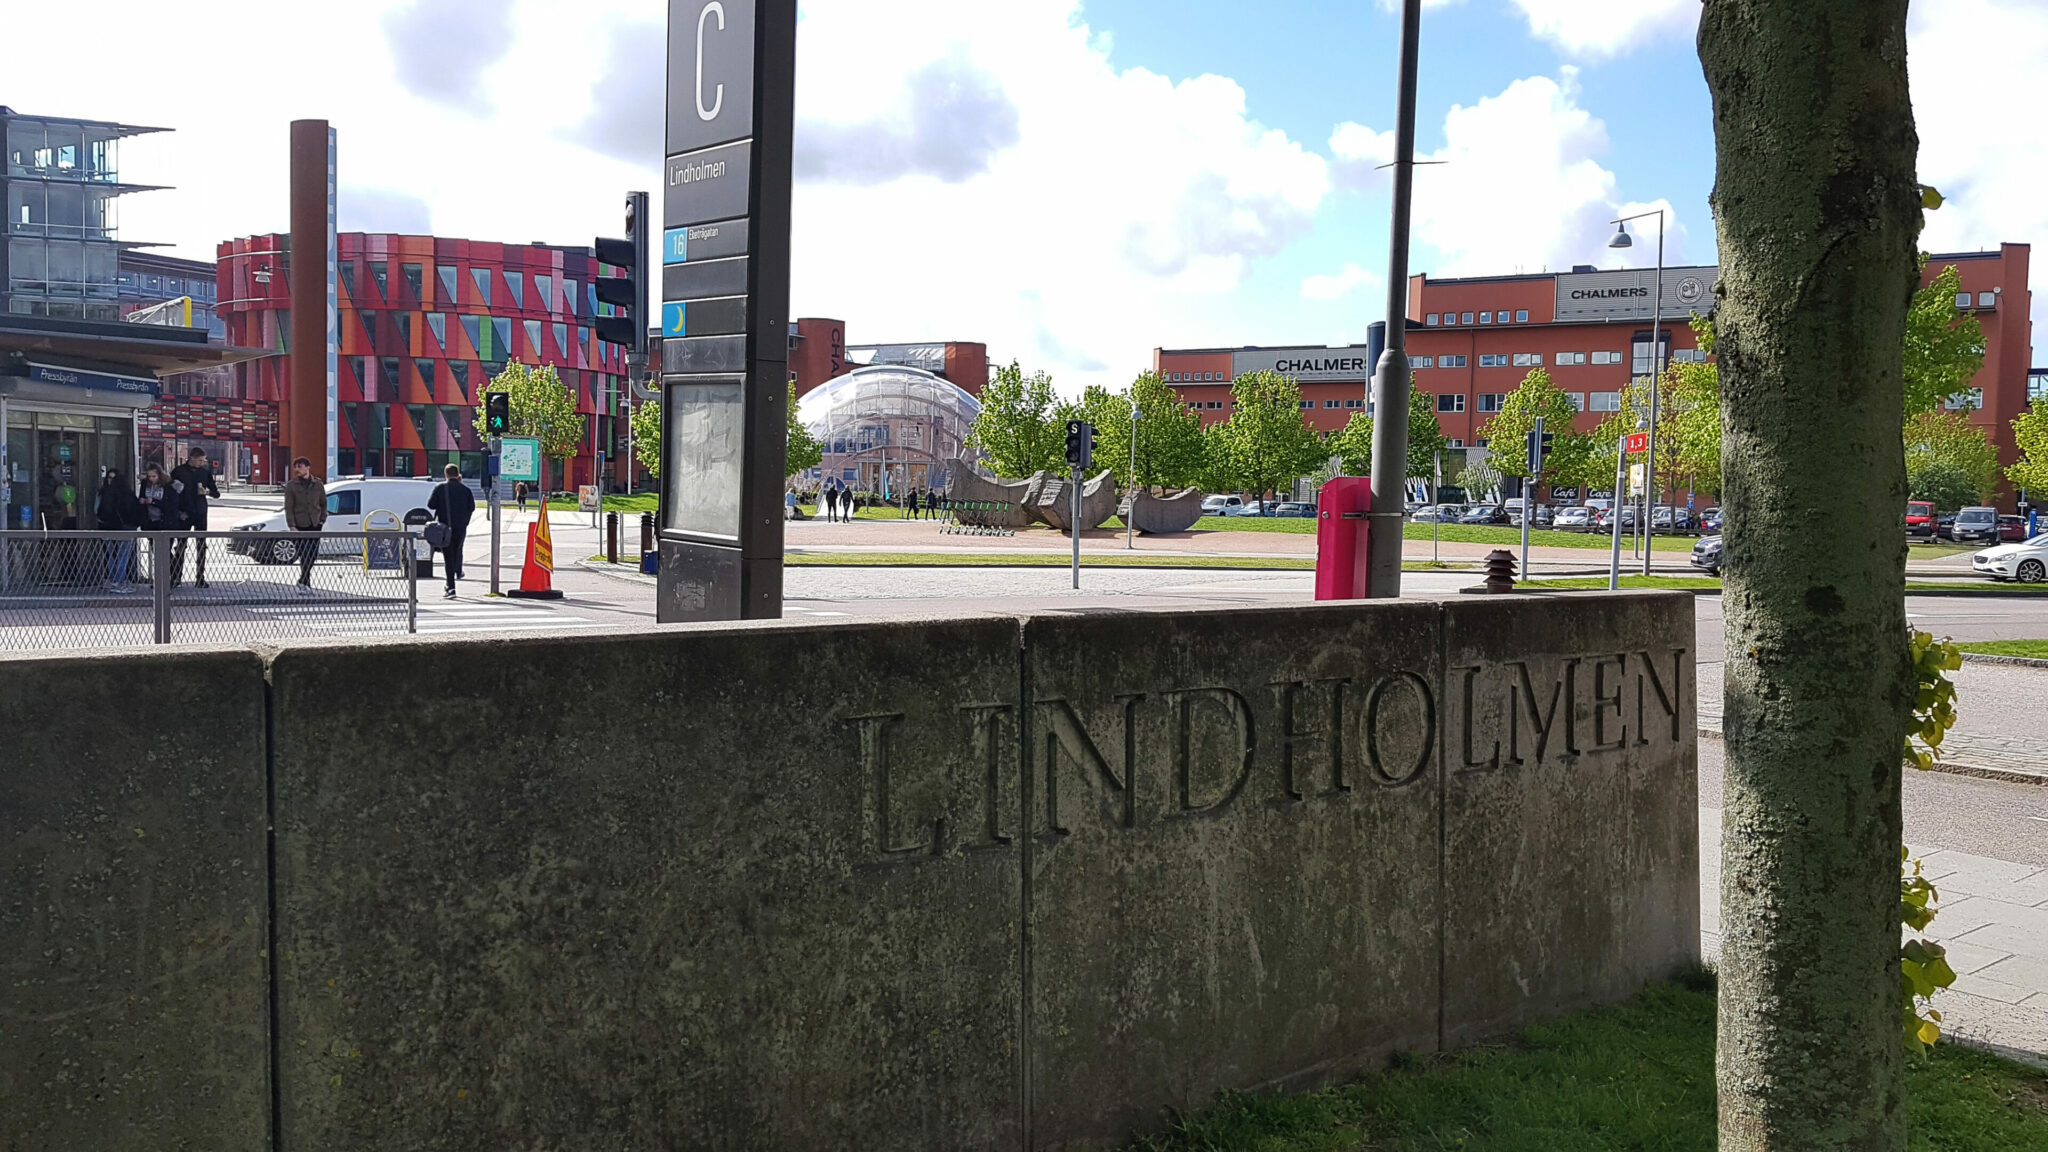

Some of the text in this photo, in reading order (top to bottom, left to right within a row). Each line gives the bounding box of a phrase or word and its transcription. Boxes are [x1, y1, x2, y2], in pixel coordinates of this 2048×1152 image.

[696, 1, 724, 121] C
[670, 160, 725, 186] Lindholmen
[673, 233, 685, 255] 16
[1571, 287, 1648, 299] CHALMERS
[831, 327, 840, 375] CHA
[40, 368, 78, 384] Pressbyrån
[116, 378, 149, 392] Pressbyrån
[1071, 423, 1078, 434] S
[1630, 438, 1643, 449] 1,3
[1553, 486, 1577, 498] Café
[845, 647, 1686, 859] LINDHOLMEN
